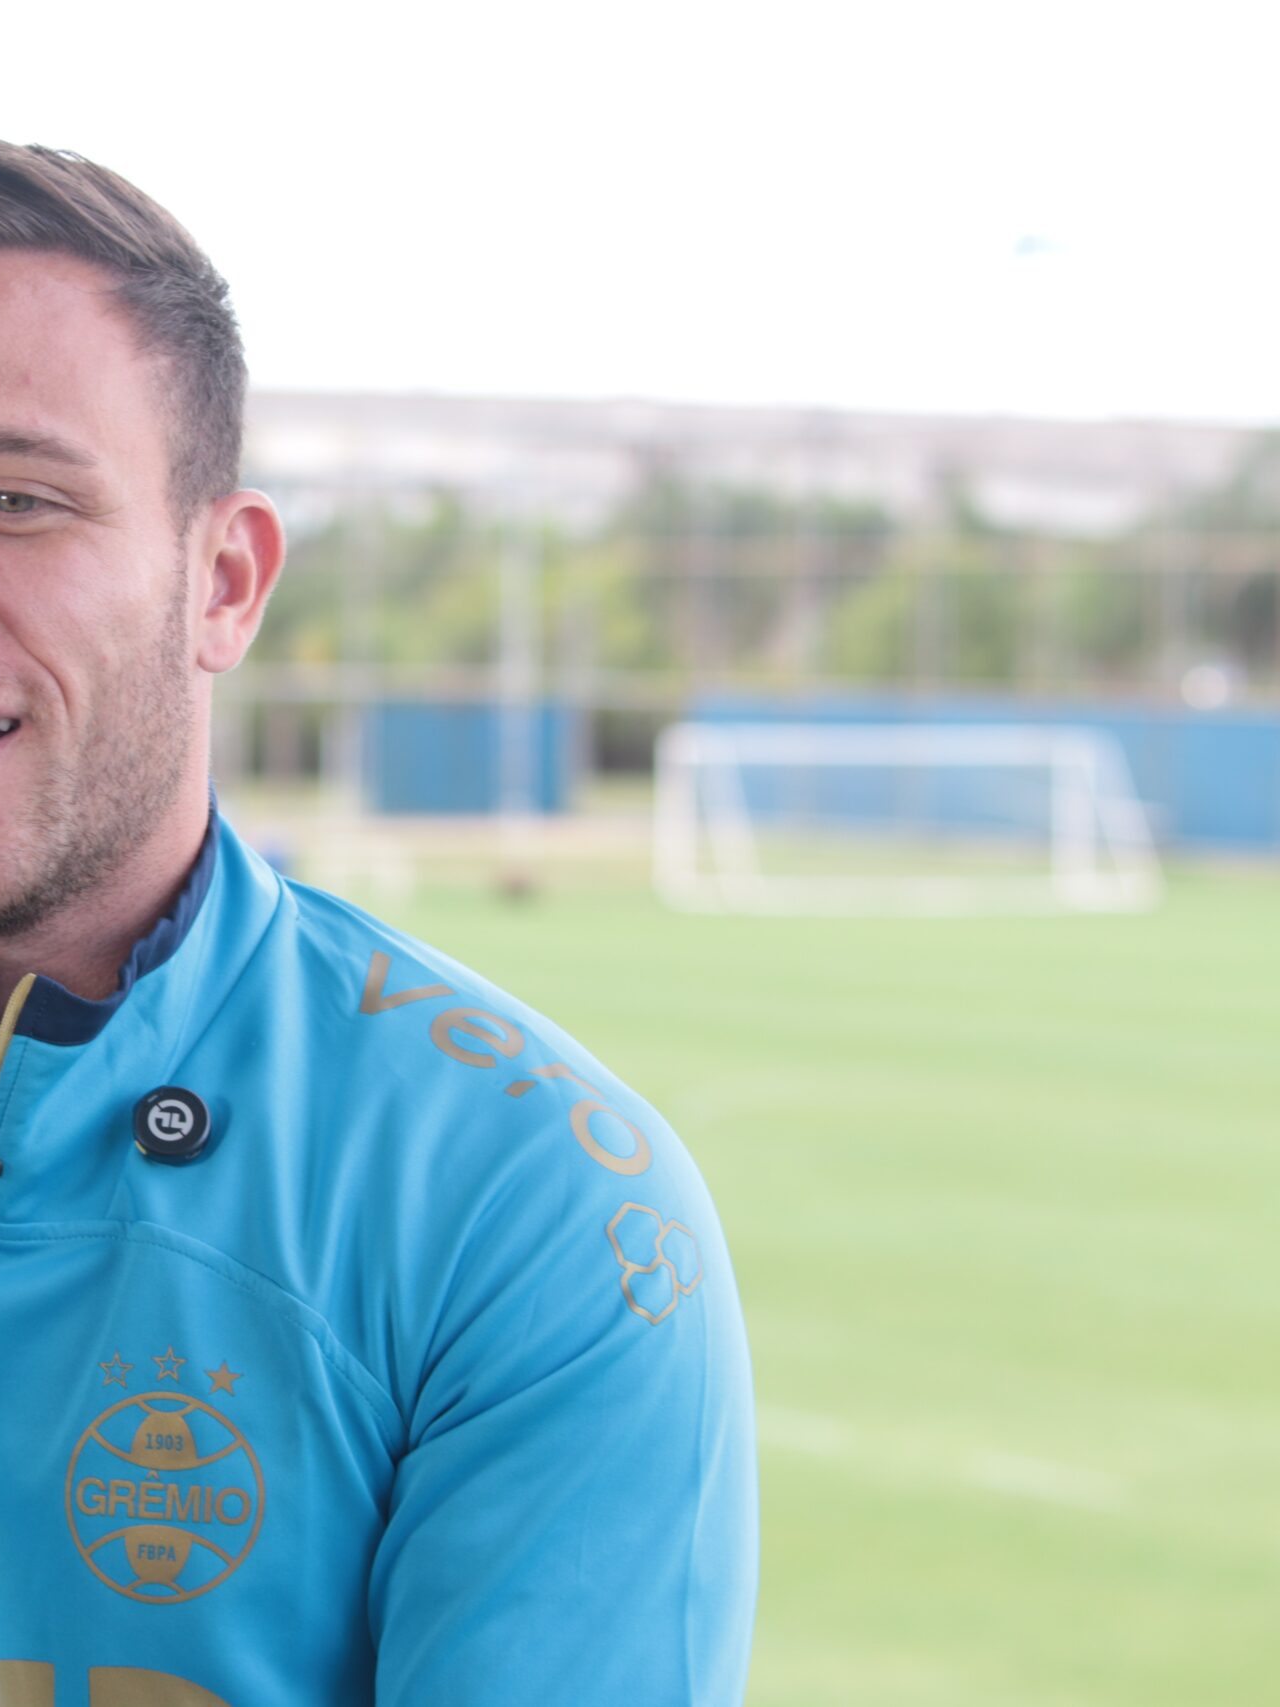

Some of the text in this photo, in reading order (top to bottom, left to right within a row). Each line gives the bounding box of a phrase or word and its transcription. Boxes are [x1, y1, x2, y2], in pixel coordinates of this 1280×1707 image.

[145, 1433, 184, 1451] 1903
[76, 1469, 251, 1525] GRÊMIO
[137, 1544, 176, 1561] FBPA
